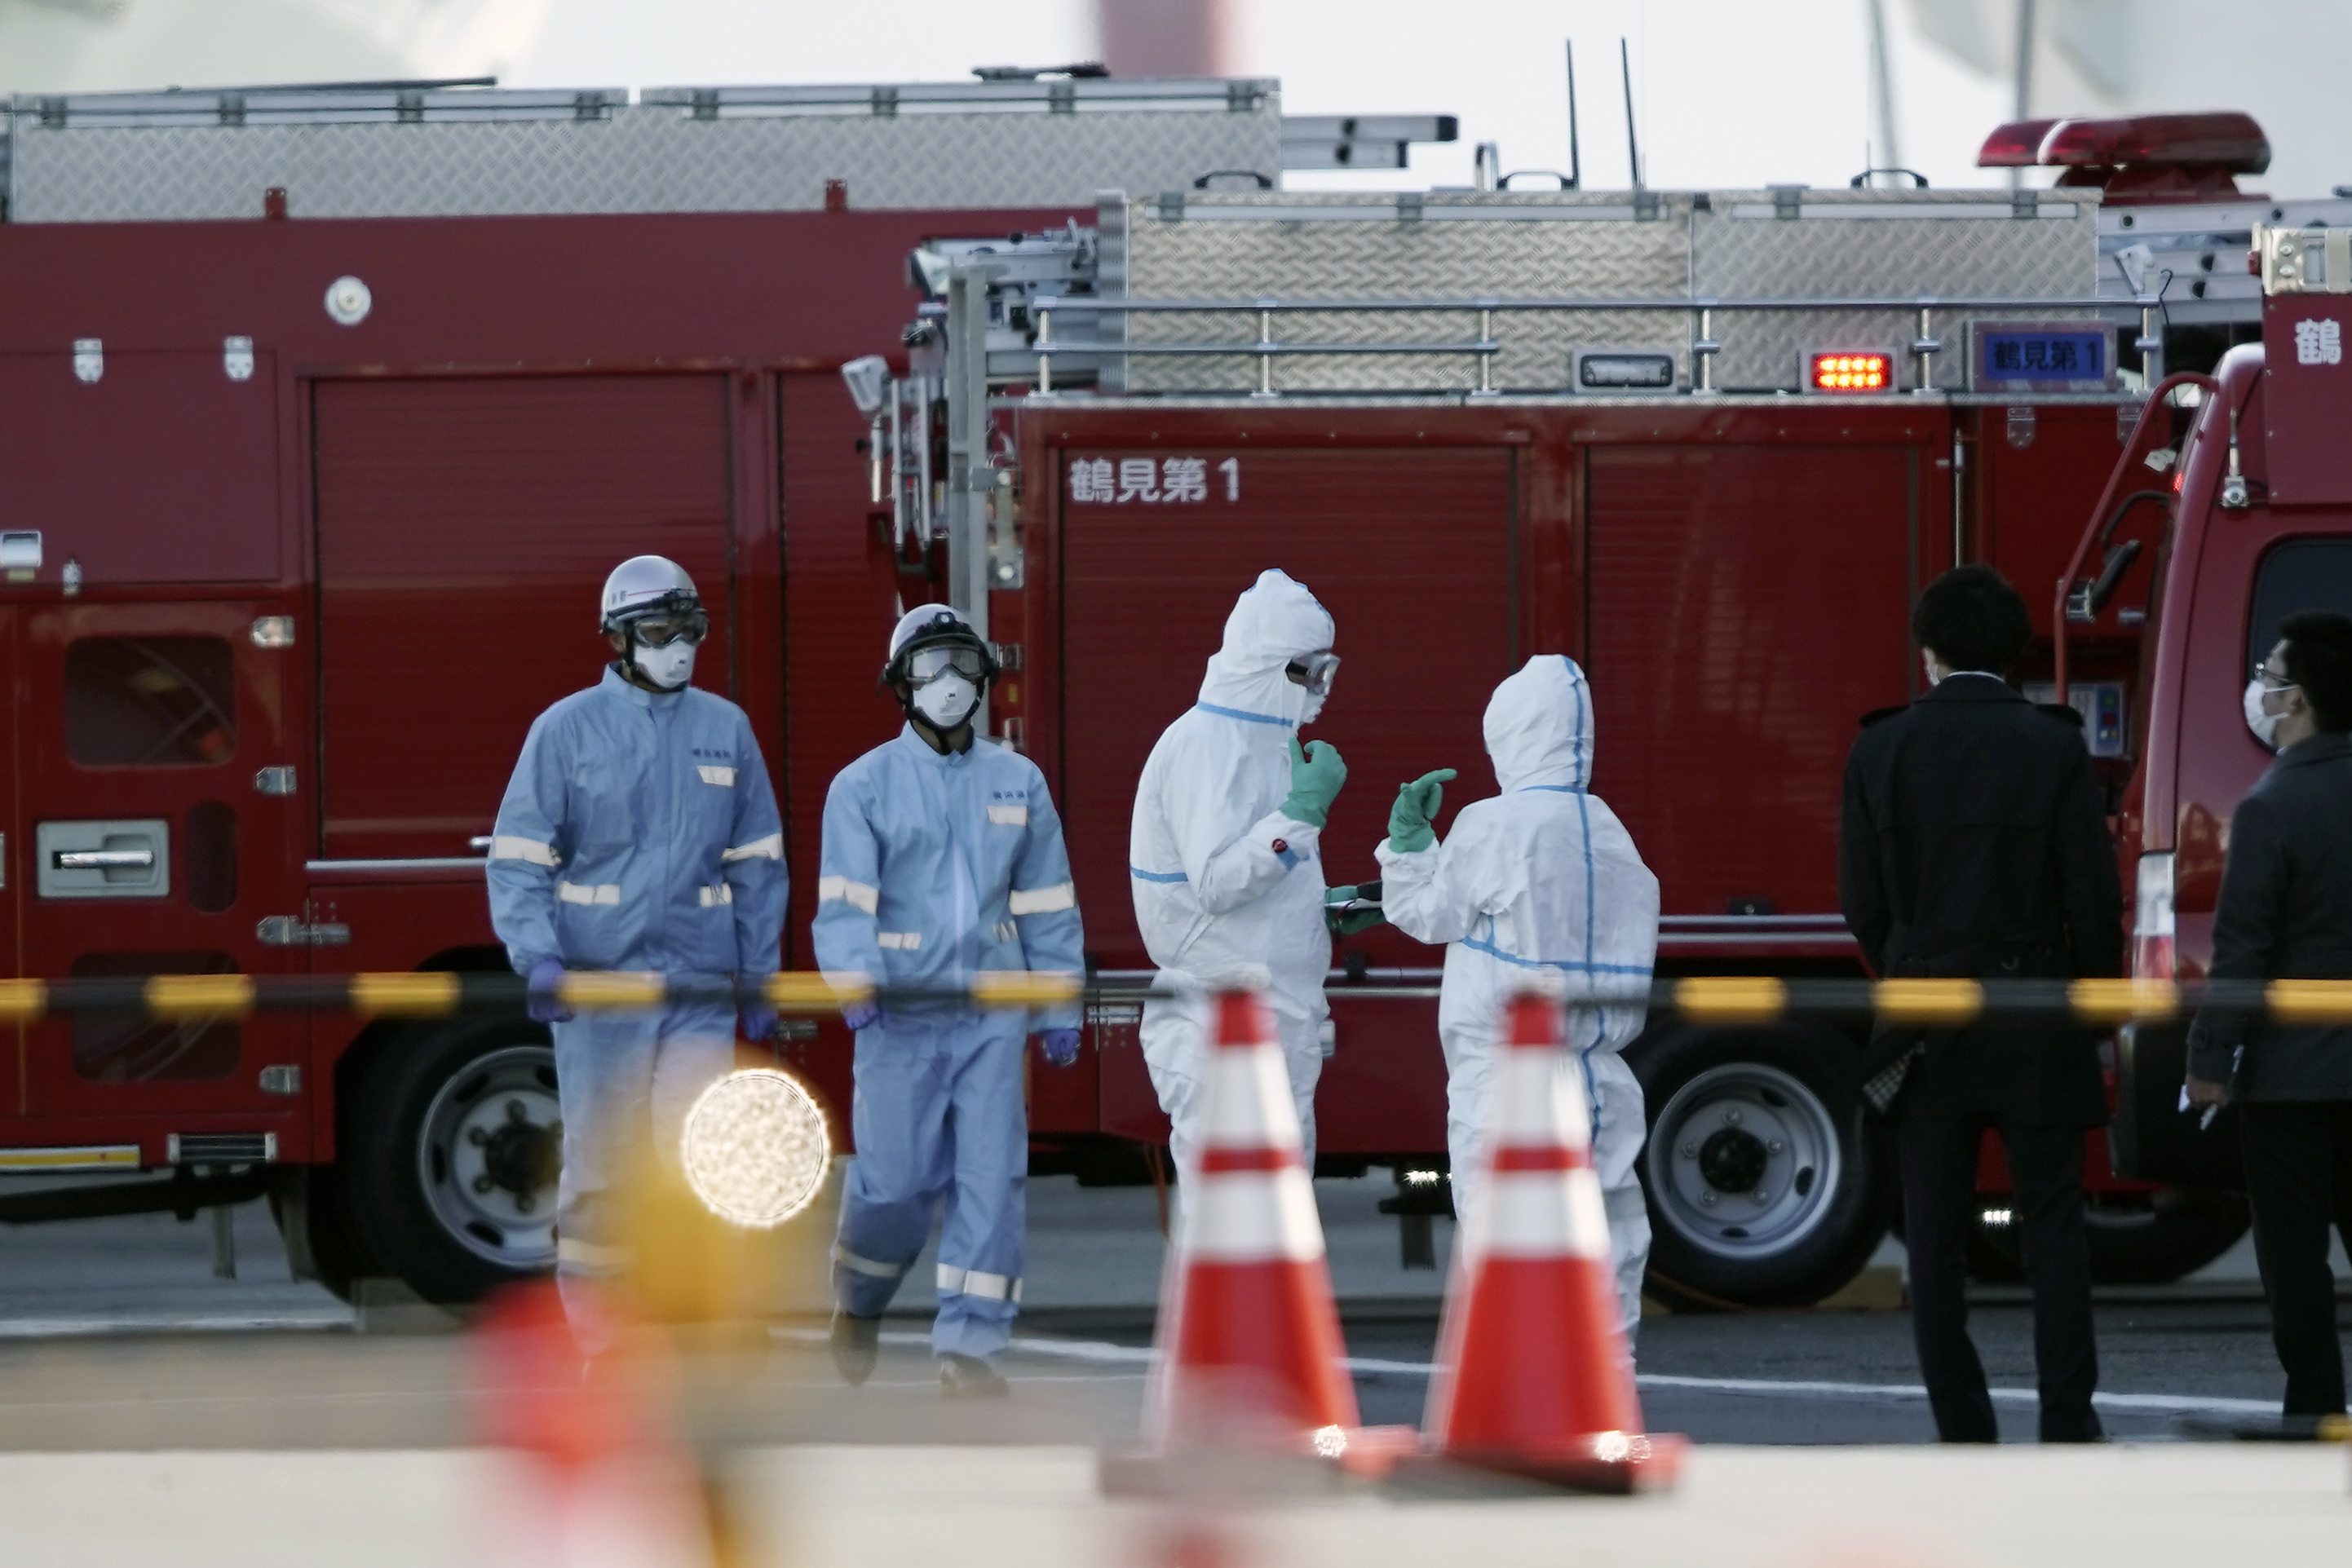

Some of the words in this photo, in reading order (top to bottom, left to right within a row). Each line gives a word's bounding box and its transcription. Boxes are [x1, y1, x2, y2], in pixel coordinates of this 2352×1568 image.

[1995, 340, 2097, 370] 鶴見第1
[2295, 318, 2341, 364] 鶴
[1070, 457, 1240, 503] 鶴見第1
